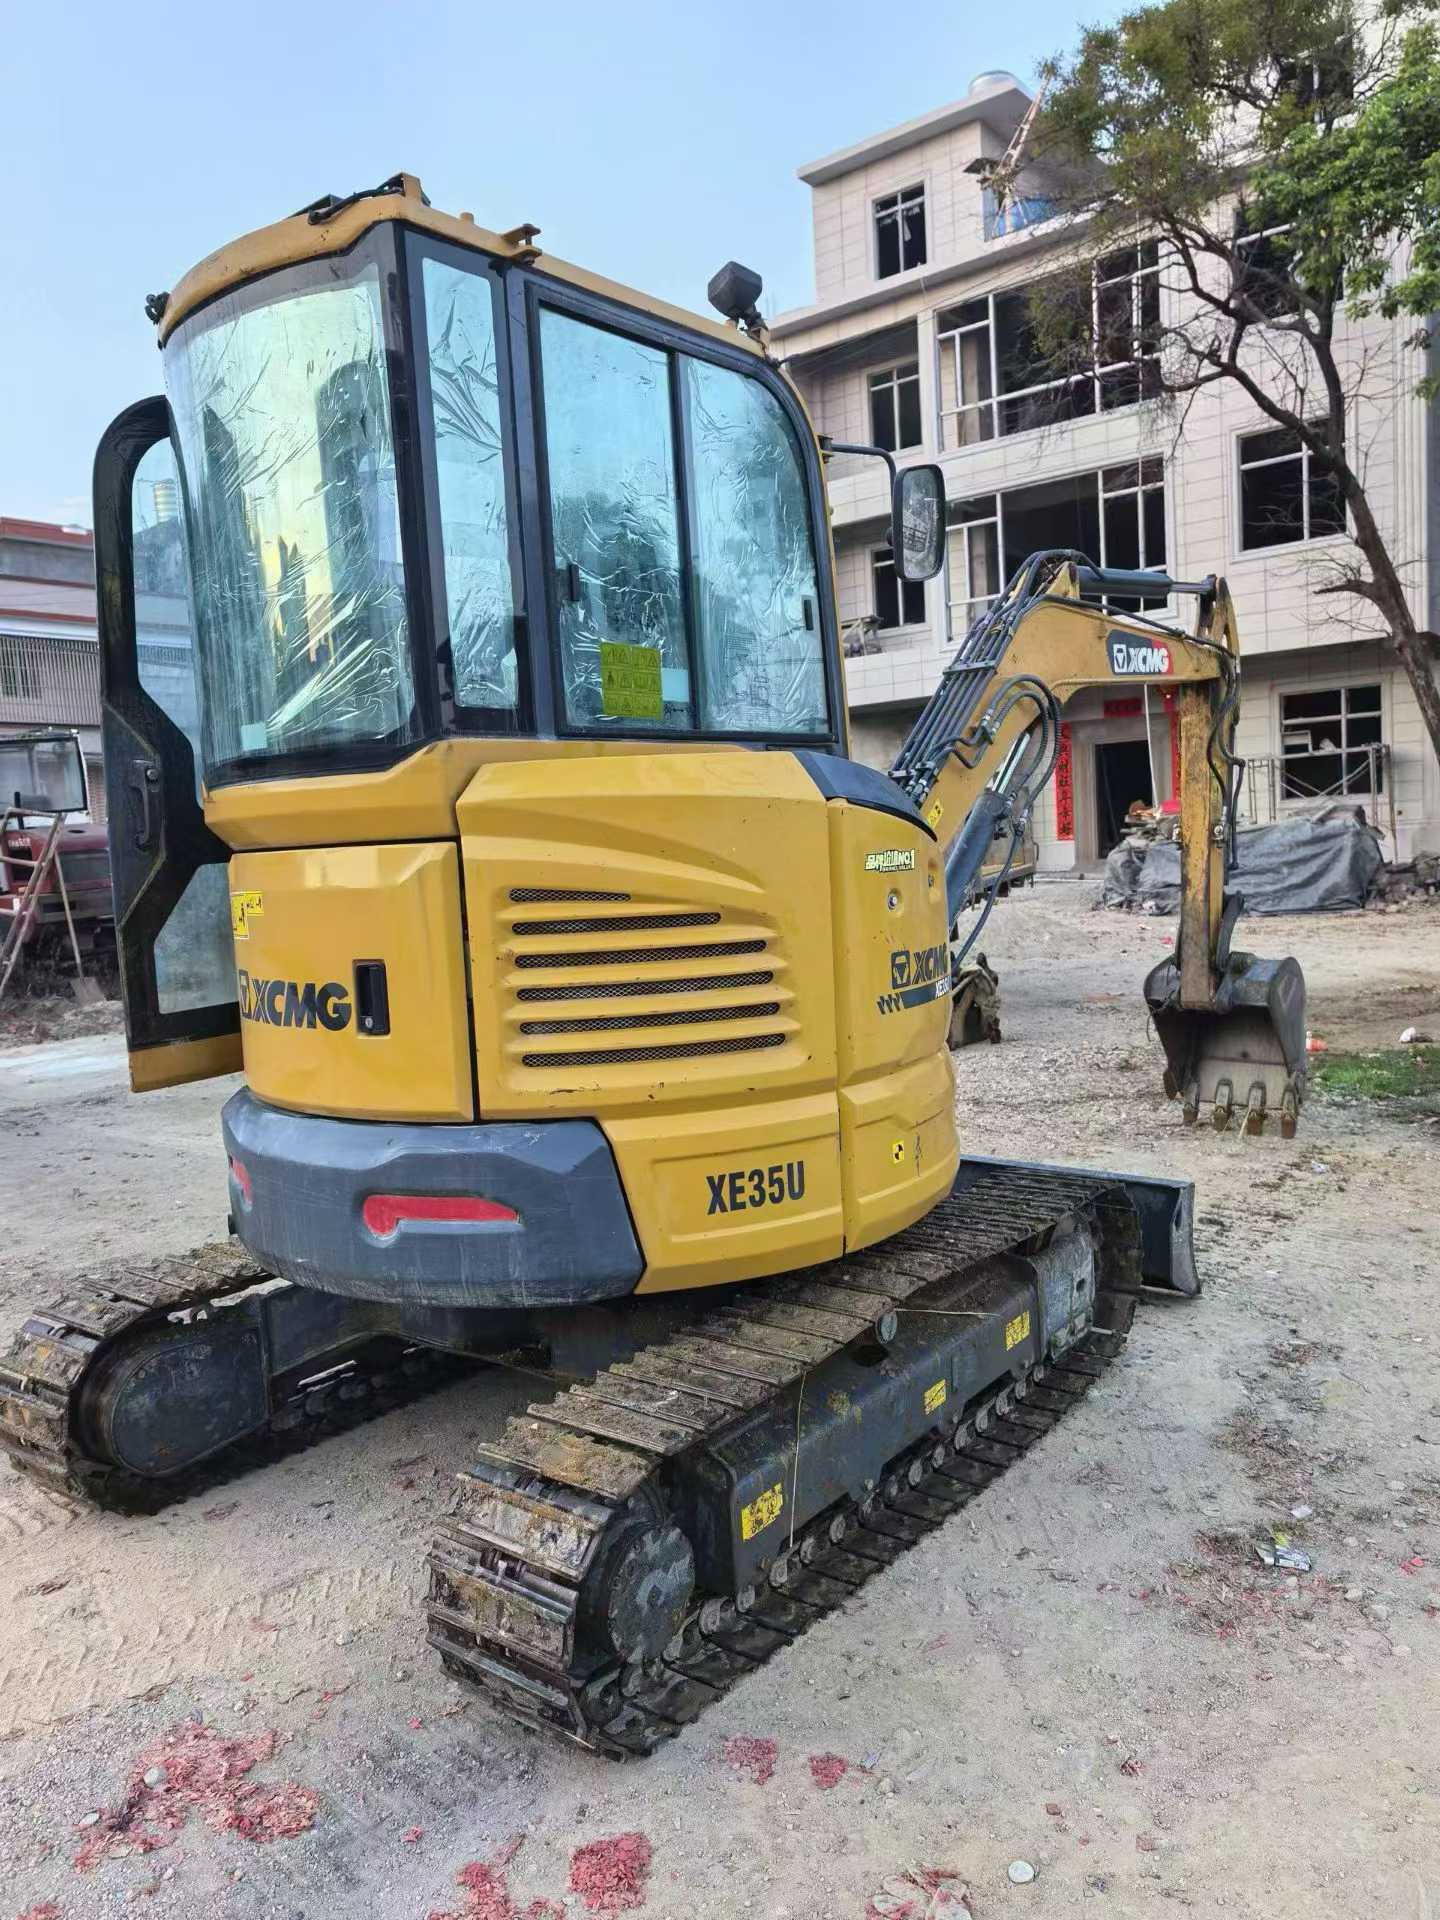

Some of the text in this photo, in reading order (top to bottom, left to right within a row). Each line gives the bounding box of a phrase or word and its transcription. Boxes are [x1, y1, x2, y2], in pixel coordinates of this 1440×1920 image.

[1128, 646, 1169, 673] XCMG
[252, 978, 352, 1031] XCMG
[706, 1160, 805, 1216] XE35U
